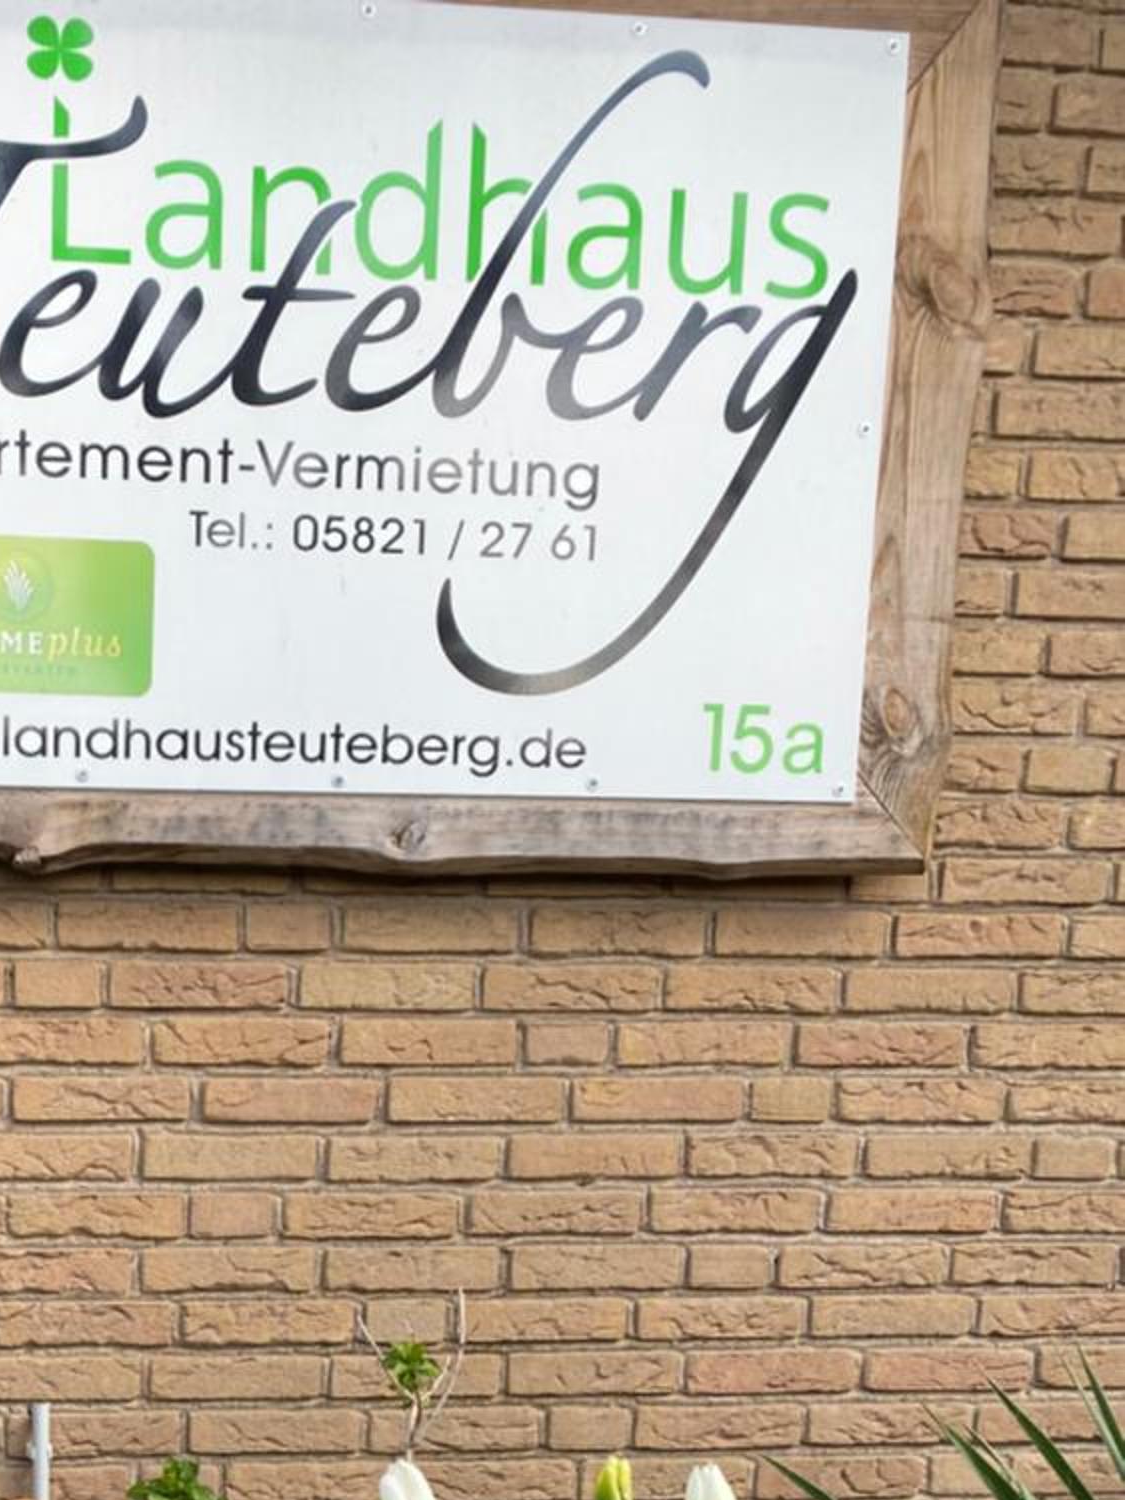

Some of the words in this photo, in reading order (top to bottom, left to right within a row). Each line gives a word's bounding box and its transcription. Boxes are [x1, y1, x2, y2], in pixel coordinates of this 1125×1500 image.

[51, 95, 831, 299] Landhaus
[189, 510, 274, 550] Tel.:
[292, 514, 427, 555] 05821
[447, 519, 465, 561] /
[479, 521, 533, 559] 27
[550, 524, 598, 561] 61
[702, 702, 825, 775] 15a
